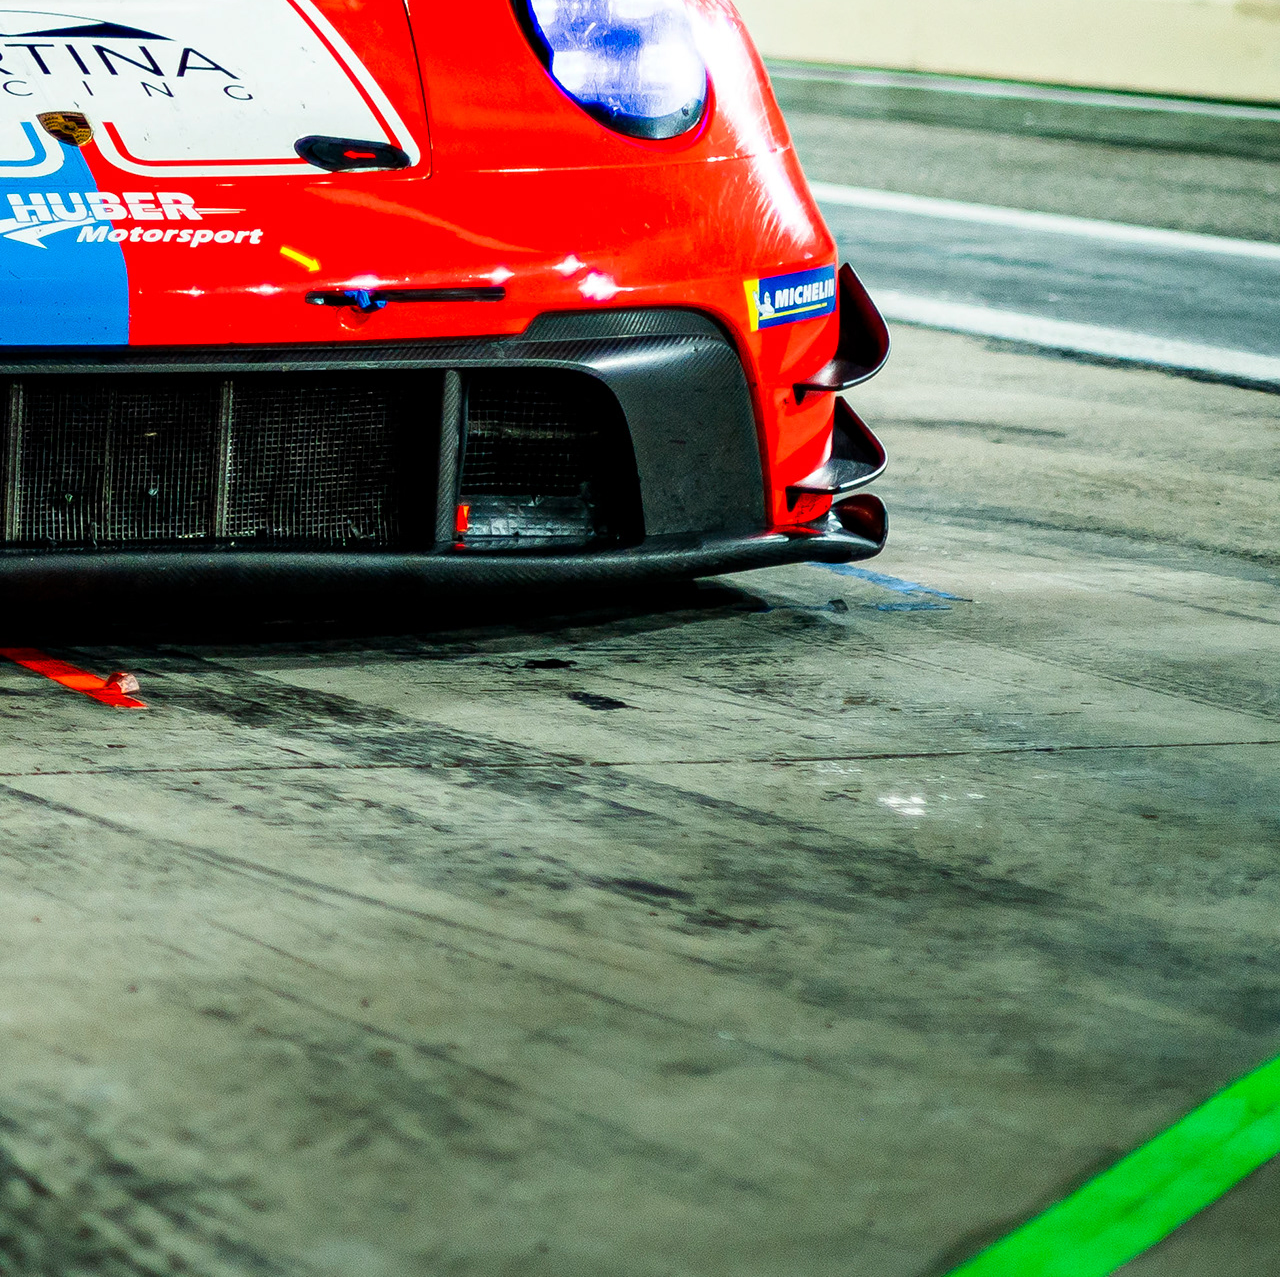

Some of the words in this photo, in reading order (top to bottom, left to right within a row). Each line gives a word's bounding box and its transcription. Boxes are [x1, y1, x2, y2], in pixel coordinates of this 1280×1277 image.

[6, 191, 203, 223] HUBER
[76, 225, 264, 248] Motorsport
[774, 278, 836, 309] MICHELIN
